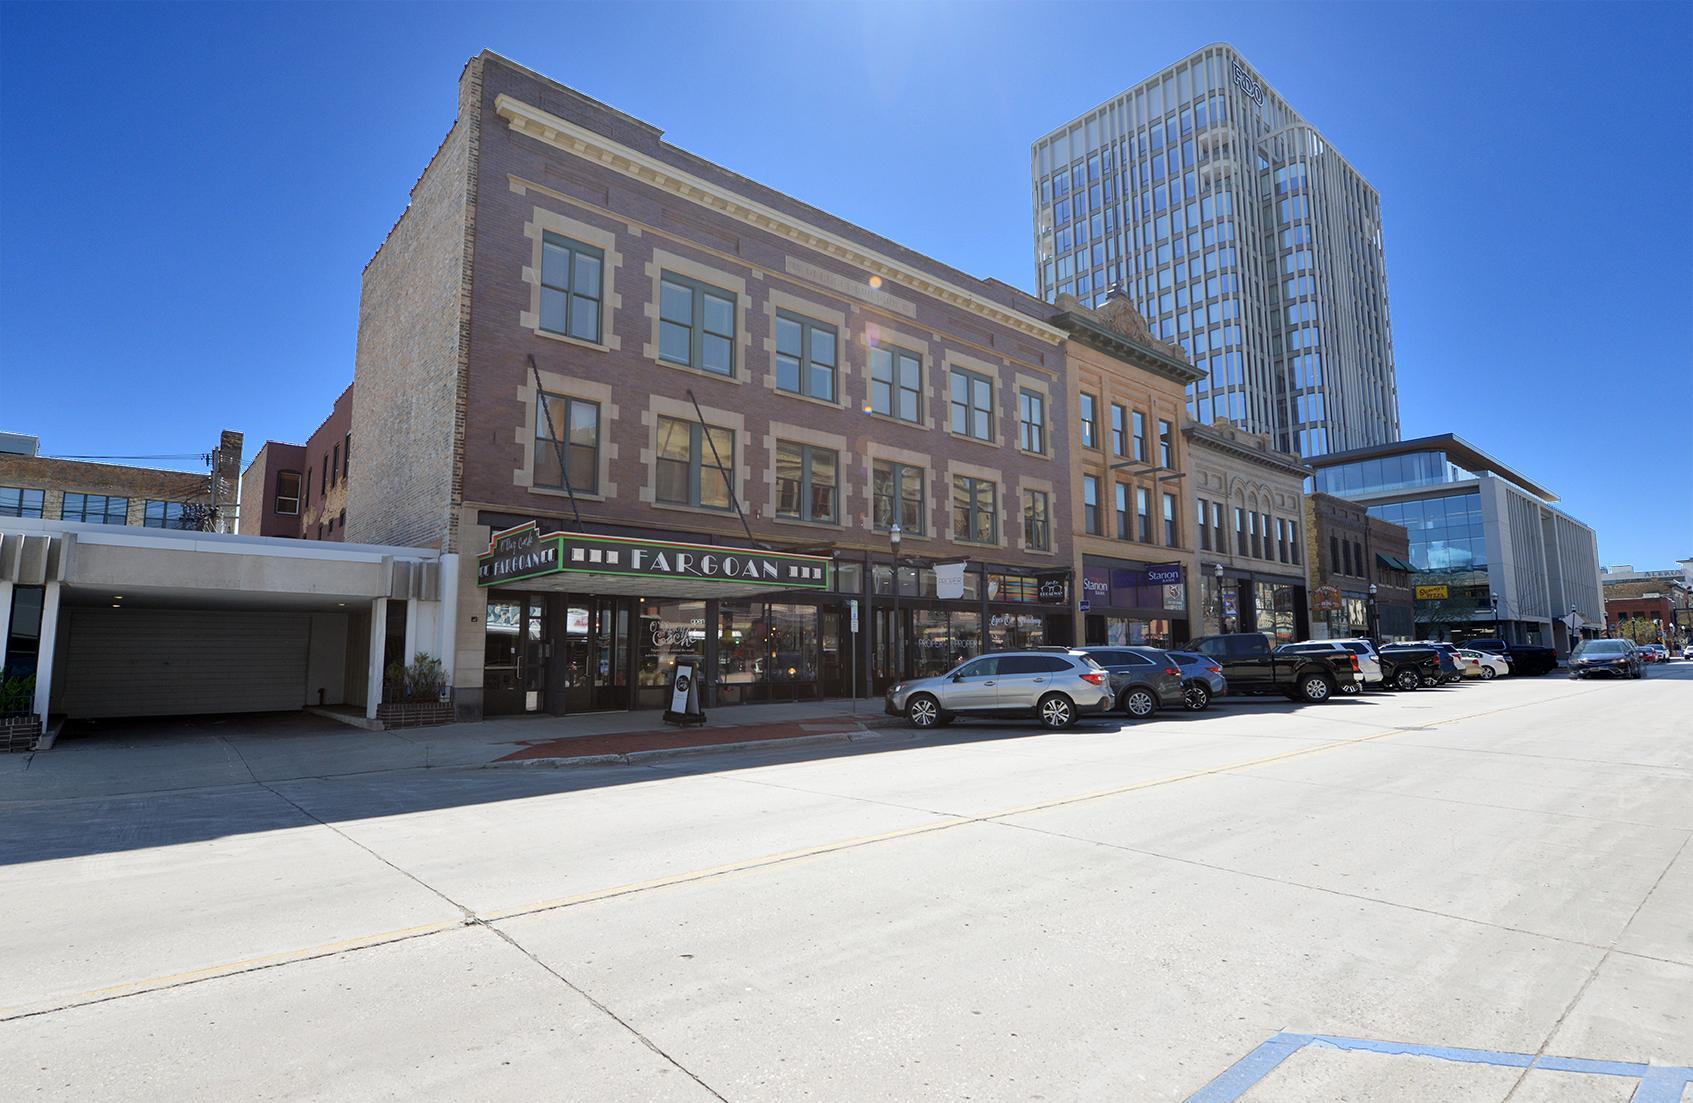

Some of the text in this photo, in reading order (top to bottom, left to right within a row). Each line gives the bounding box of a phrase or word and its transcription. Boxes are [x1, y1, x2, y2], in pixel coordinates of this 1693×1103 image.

[1232, 60, 1264, 107] RDO
[494, 552, 540, 577] FARGOAN
[631, 548, 779, 579] FARGOAN
[1148, 571, 1179, 581] Starion
[1083, 577, 1108, 592] Starion
